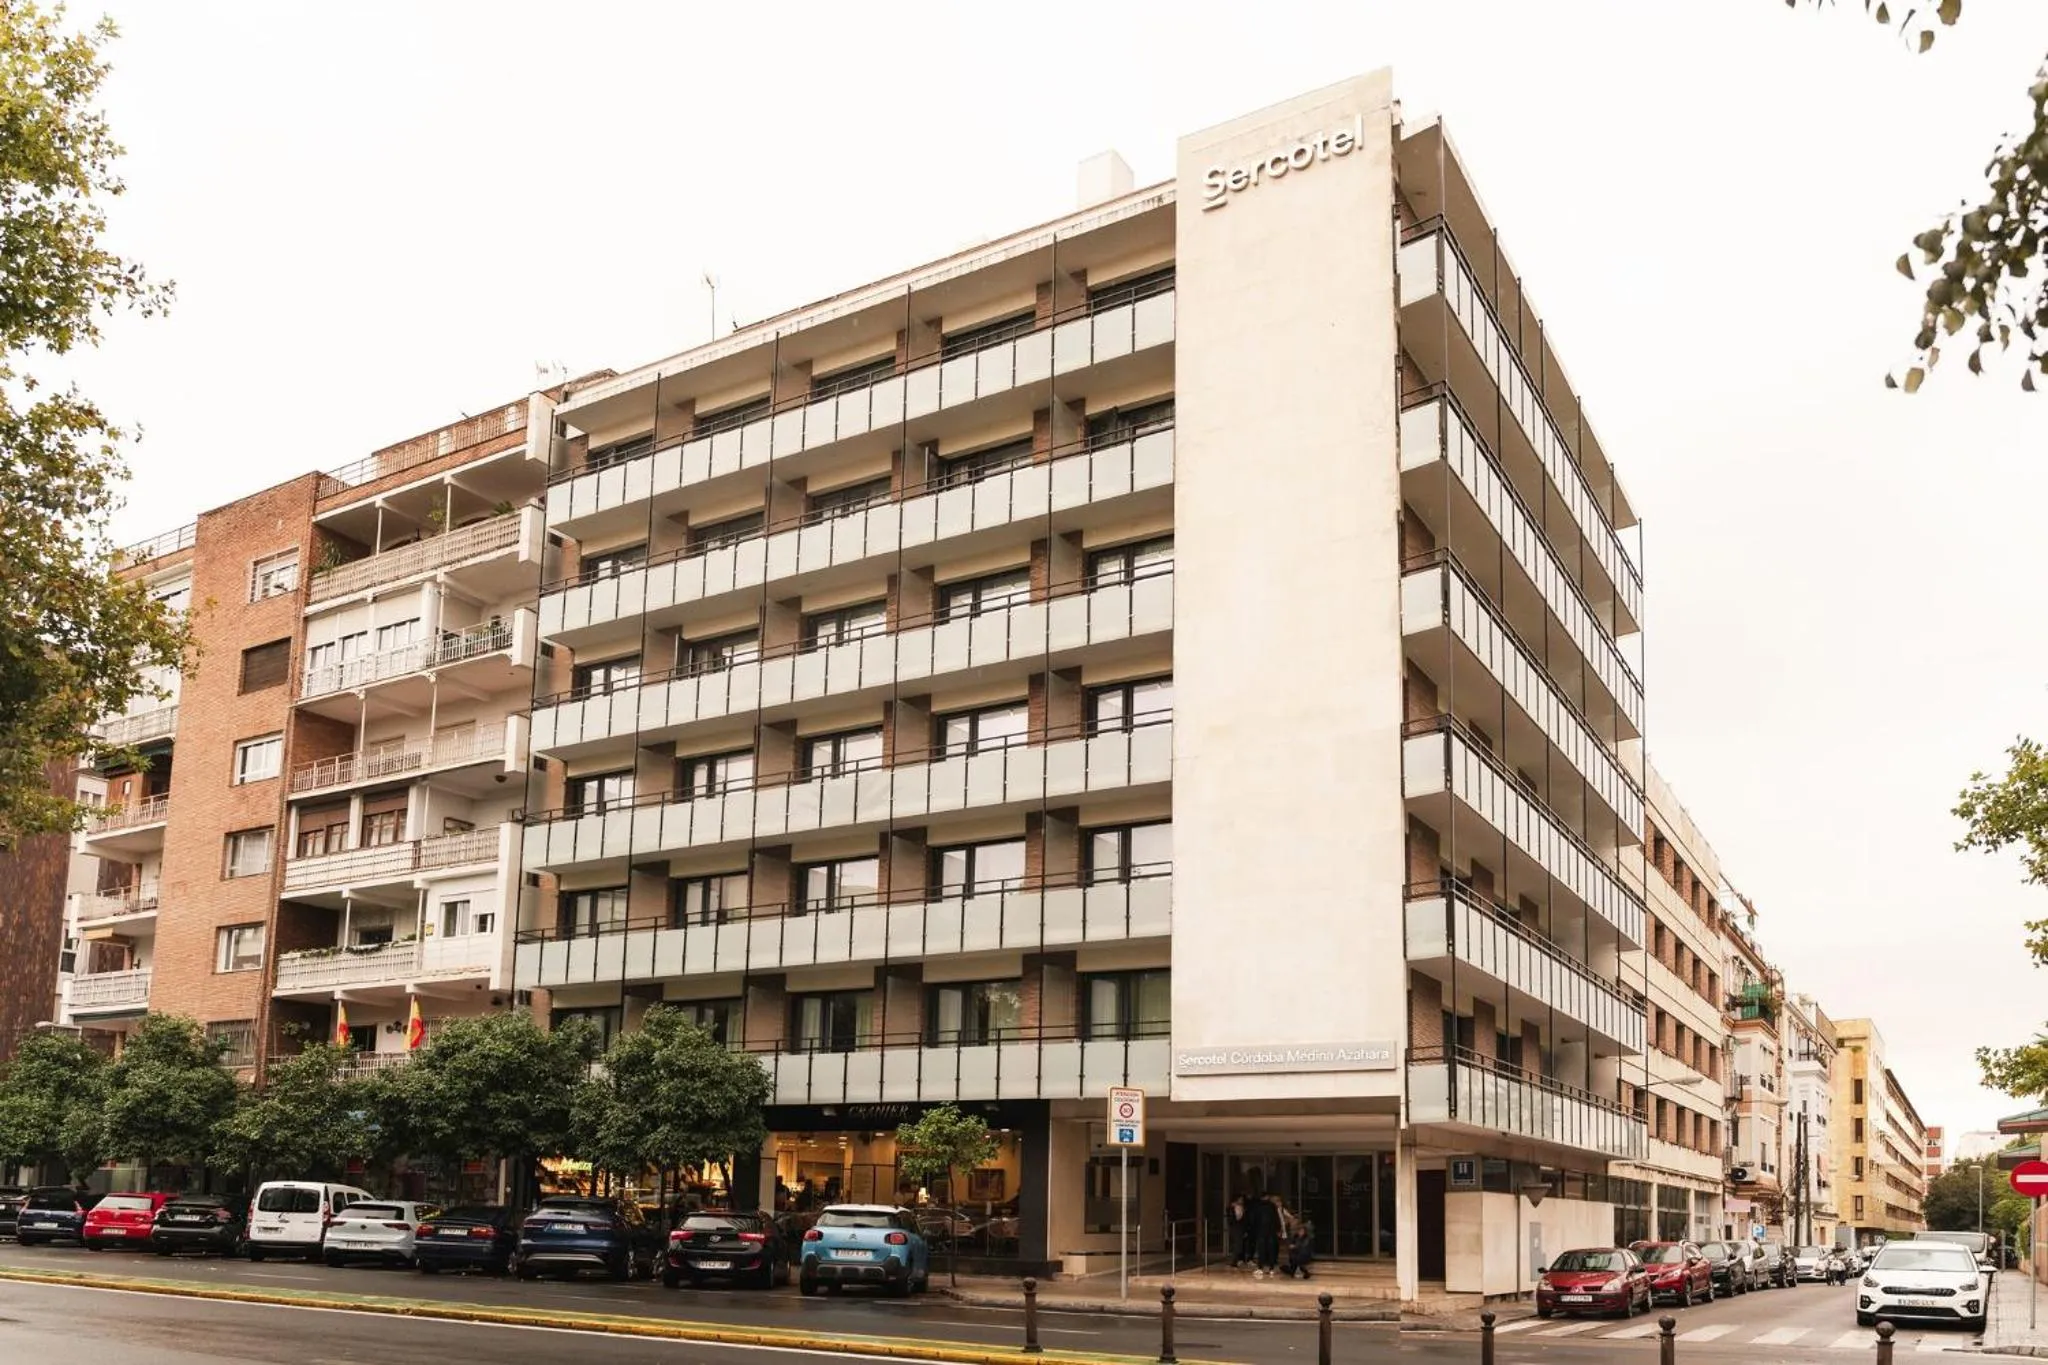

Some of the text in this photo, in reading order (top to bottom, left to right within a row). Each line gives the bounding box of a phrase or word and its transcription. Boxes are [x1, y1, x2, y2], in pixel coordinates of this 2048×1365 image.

[1202, 113, 1364, 208] Sercotel
[1179, 1052, 1227, 1067] Sercotel
[1338, 1047, 1390, 1060] Azahara
